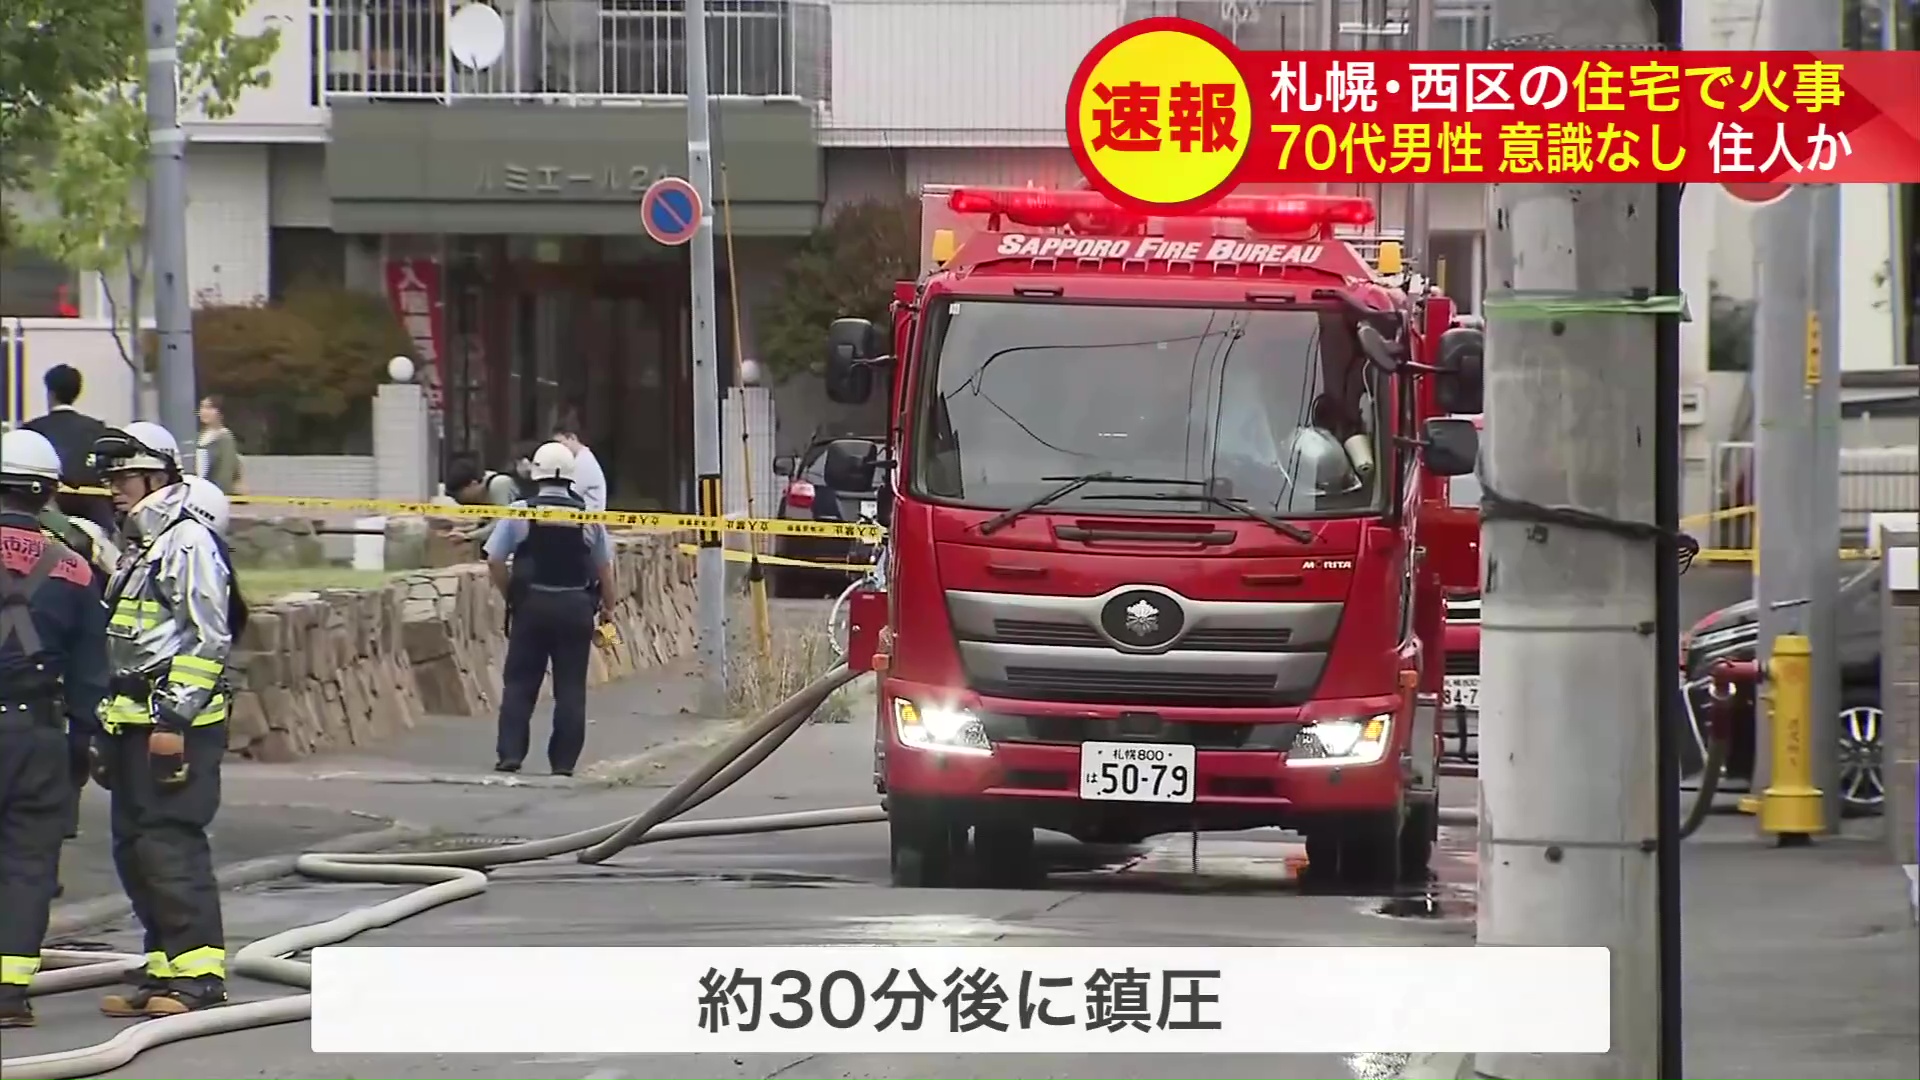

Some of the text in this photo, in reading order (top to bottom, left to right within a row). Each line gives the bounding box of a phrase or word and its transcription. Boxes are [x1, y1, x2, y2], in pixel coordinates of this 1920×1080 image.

[997, 234, 1324, 264] SAPPORO FIRE BUREAU
